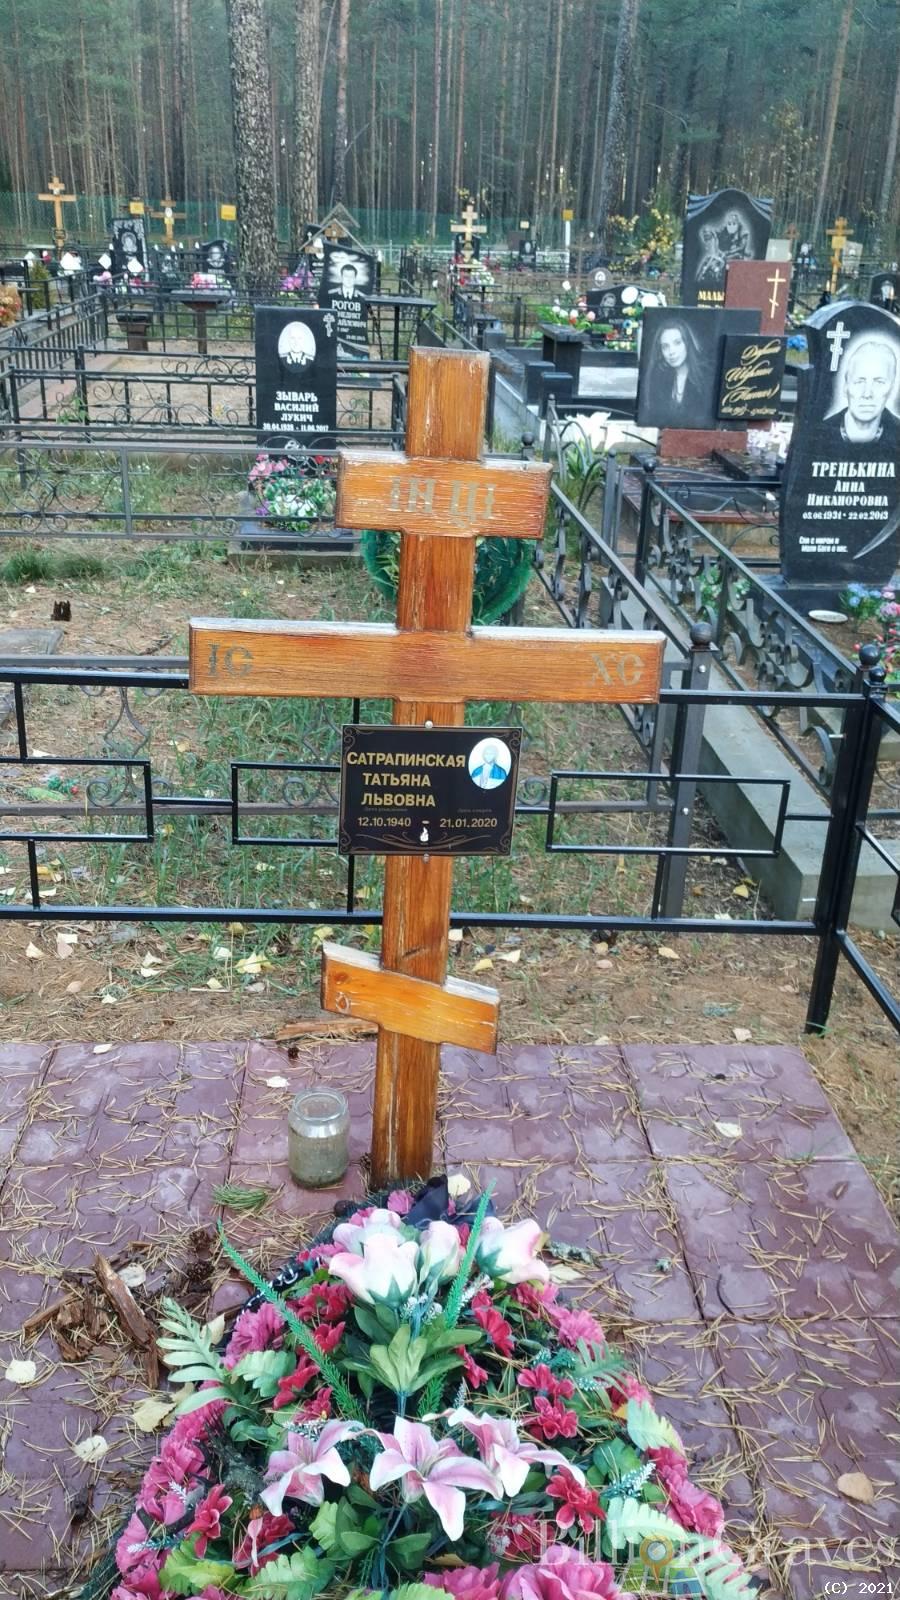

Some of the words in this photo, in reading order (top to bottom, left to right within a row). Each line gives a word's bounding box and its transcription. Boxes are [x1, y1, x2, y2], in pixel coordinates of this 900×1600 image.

[332, 299, 361, 311] РОГОВ
[276, 391, 318, 402] ЗЫВАРЬ
[274, 402, 319, 412] ВАСИЛИЙ
[281, 413, 313, 422] ЛУКИЧ
[811, 461, 896, 478] ТРЕНЬКИНА
[346, 751, 466, 768] САТРАПИНСКАЯ
[362, 772, 432, 787] ТАТЬЯНА
[361, 792, 436, 807] ЛЬВОВНА
[357, 816, 412, 827] 12.10.1940
[439, 817, 498, 828] 21.01.2020
